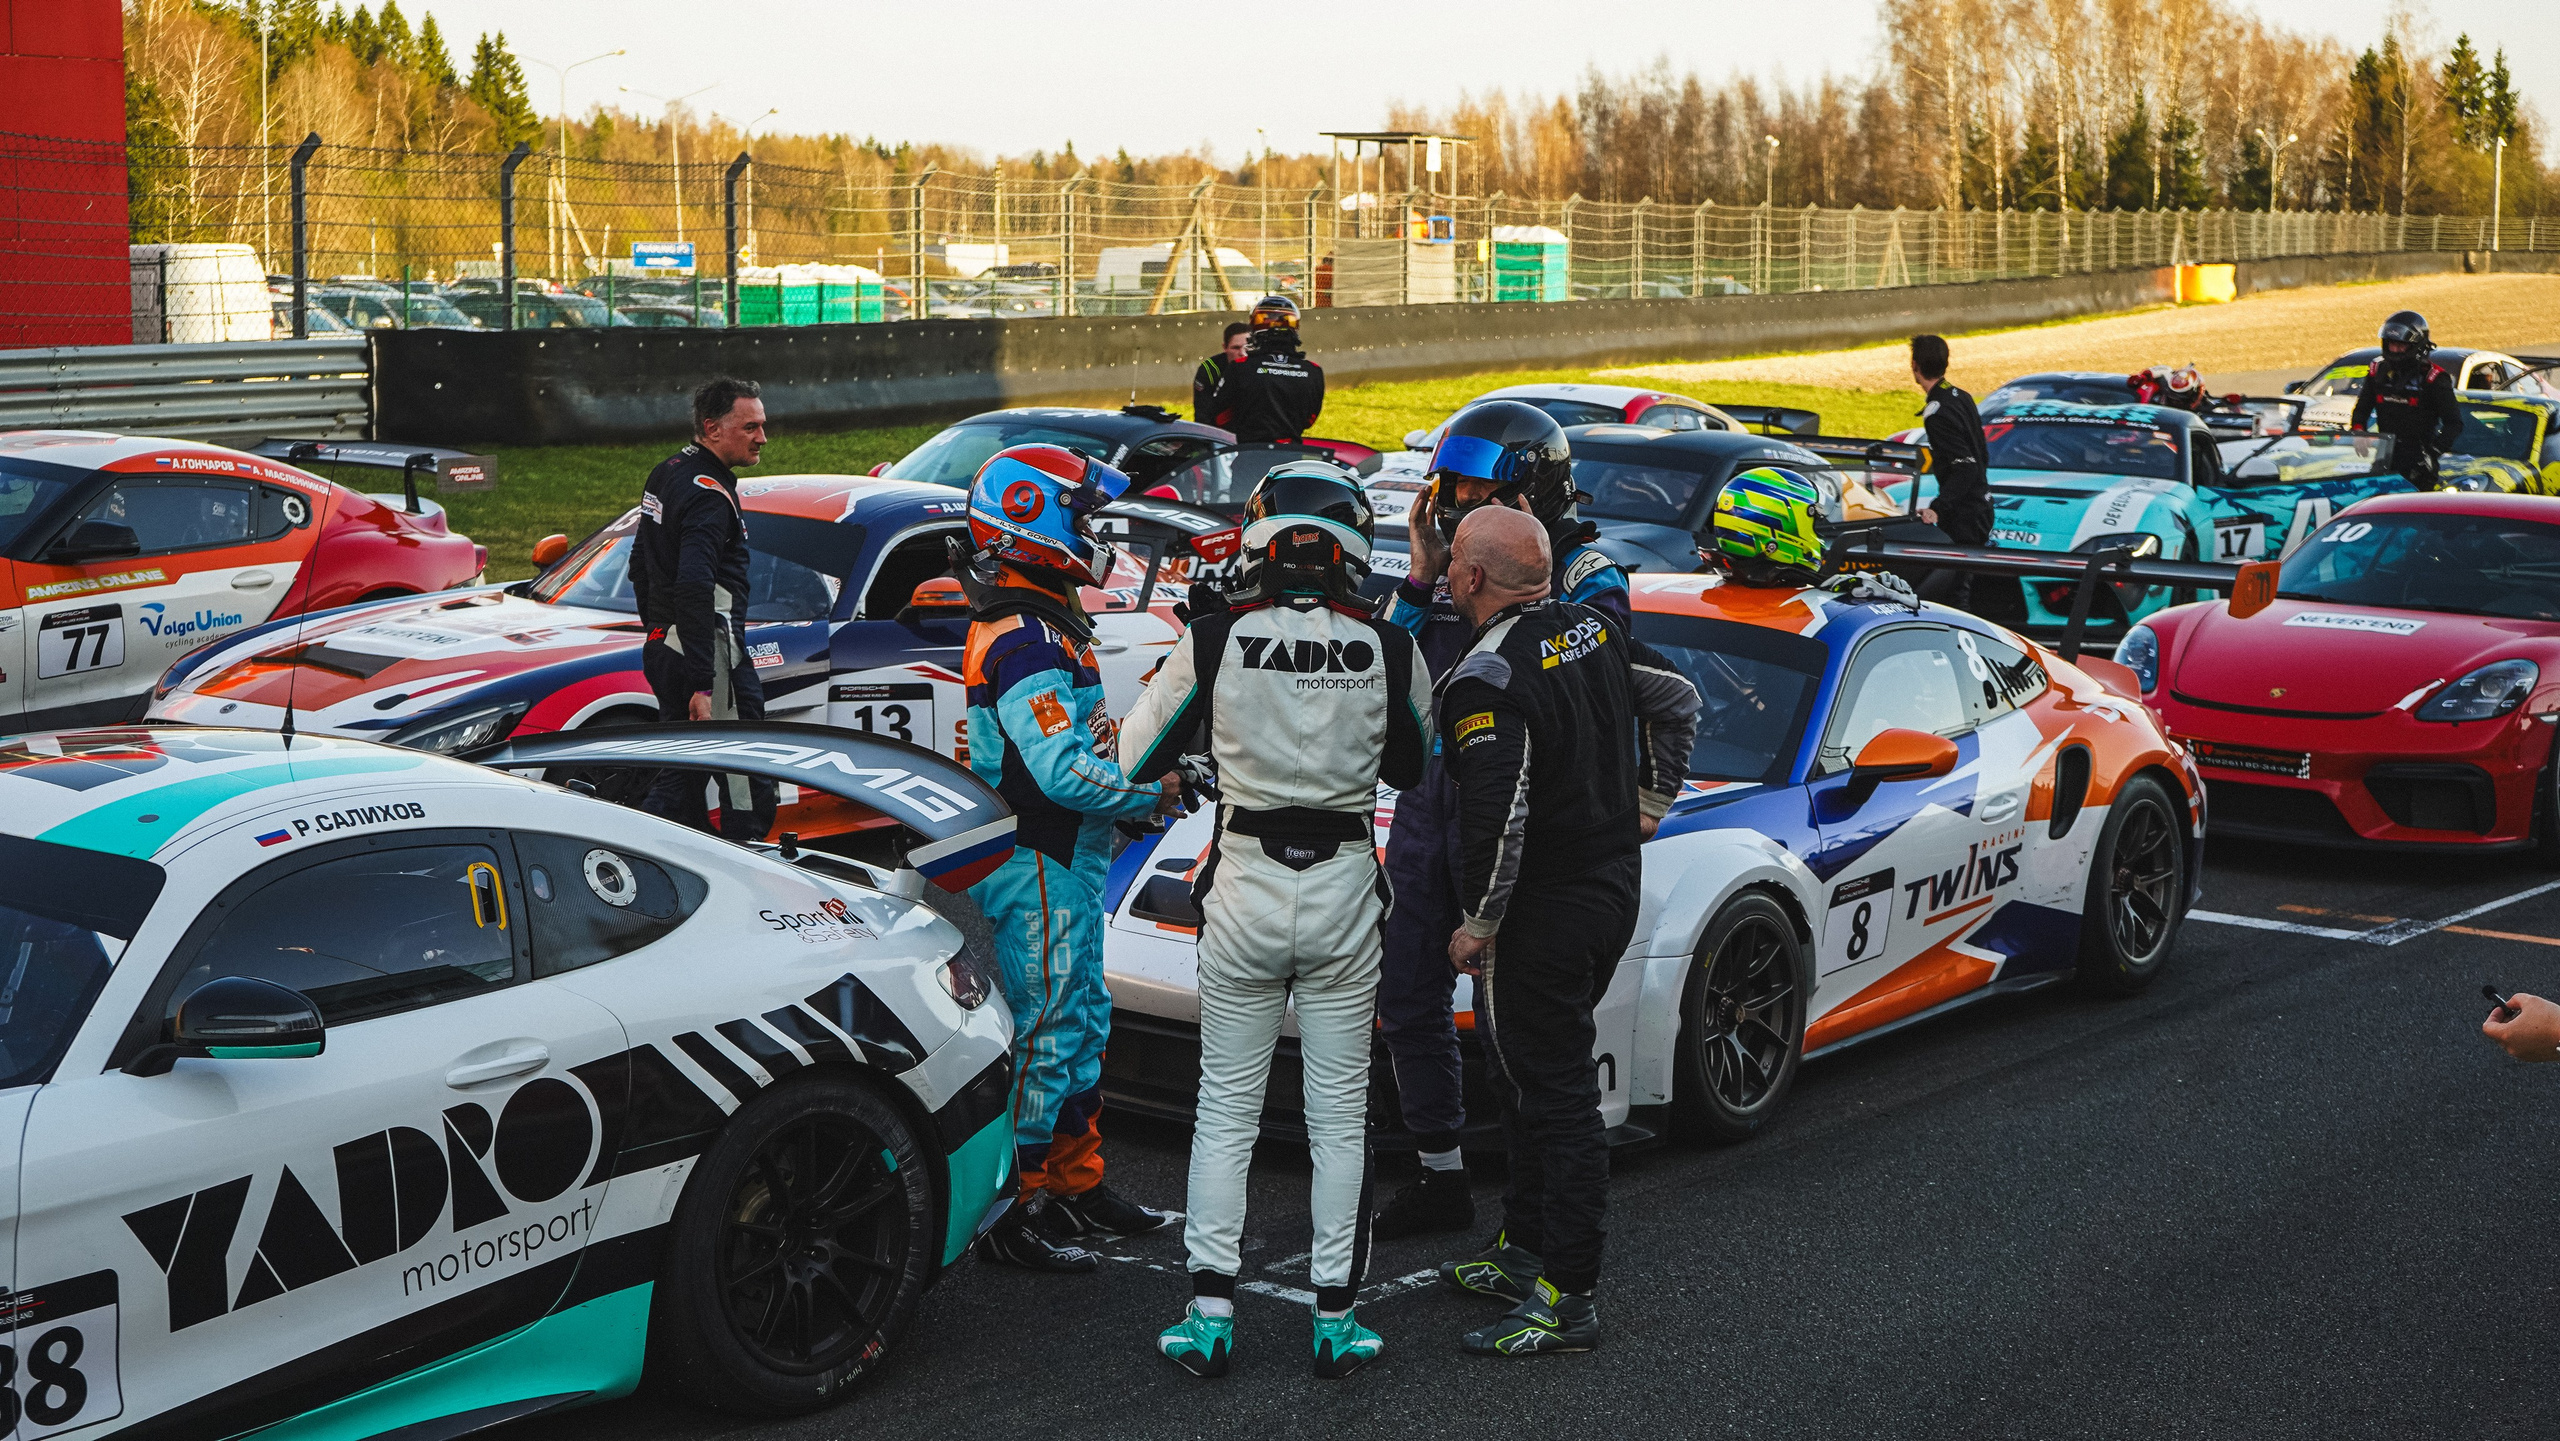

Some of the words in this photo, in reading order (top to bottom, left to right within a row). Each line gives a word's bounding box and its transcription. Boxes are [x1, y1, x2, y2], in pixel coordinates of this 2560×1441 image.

[172, 458, 235, 471] А.ГОНЧАРОВ
[449, 466, 481, 475] AMAZING
[454, 472, 485, 482] ONLINE
[1010, 486, 1035, 517] 9
[1026, 531, 1058, 545] GORIN
[1292, 531, 1320, 547] hans
[2220, 528, 2252, 558] 17
[2321, 521, 2373, 543] 10
[1283, 562, 1297, 570] PRO
[28, 578, 100, 599] AMAZING
[101, 569, 166, 587] ONLINE
[51, 609, 90, 619] PORSCHE
[140, 609, 242, 637] VolgaUnion
[63, 623, 110, 671] 77
[165, 637, 194, 649] cycling
[1235, 635, 1375, 673] YADRO
[1957, 630, 1988, 682] 8
[754, 656, 779, 666] RACING
[1296, 675, 1375, 692] motorsport
[854, 703, 913, 743] 13
[1456, 715, 1490, 737] PIRELLI
[688, 741, 979, 823] AMG
[292, 801, 426, 837] Р.САЛИХОВ
[1285, 846, 1315, 859] freem
[1904, 842, 2023, 920] TWINS
[759, 908, 831, 933] Sport
[1846, 901, 1872, 961] 8
[1025, 912, 1041, 962] SPORT
[120, 1077, 594, 1333] YADRO
[402, 1197, 593, 1297] motorsport
